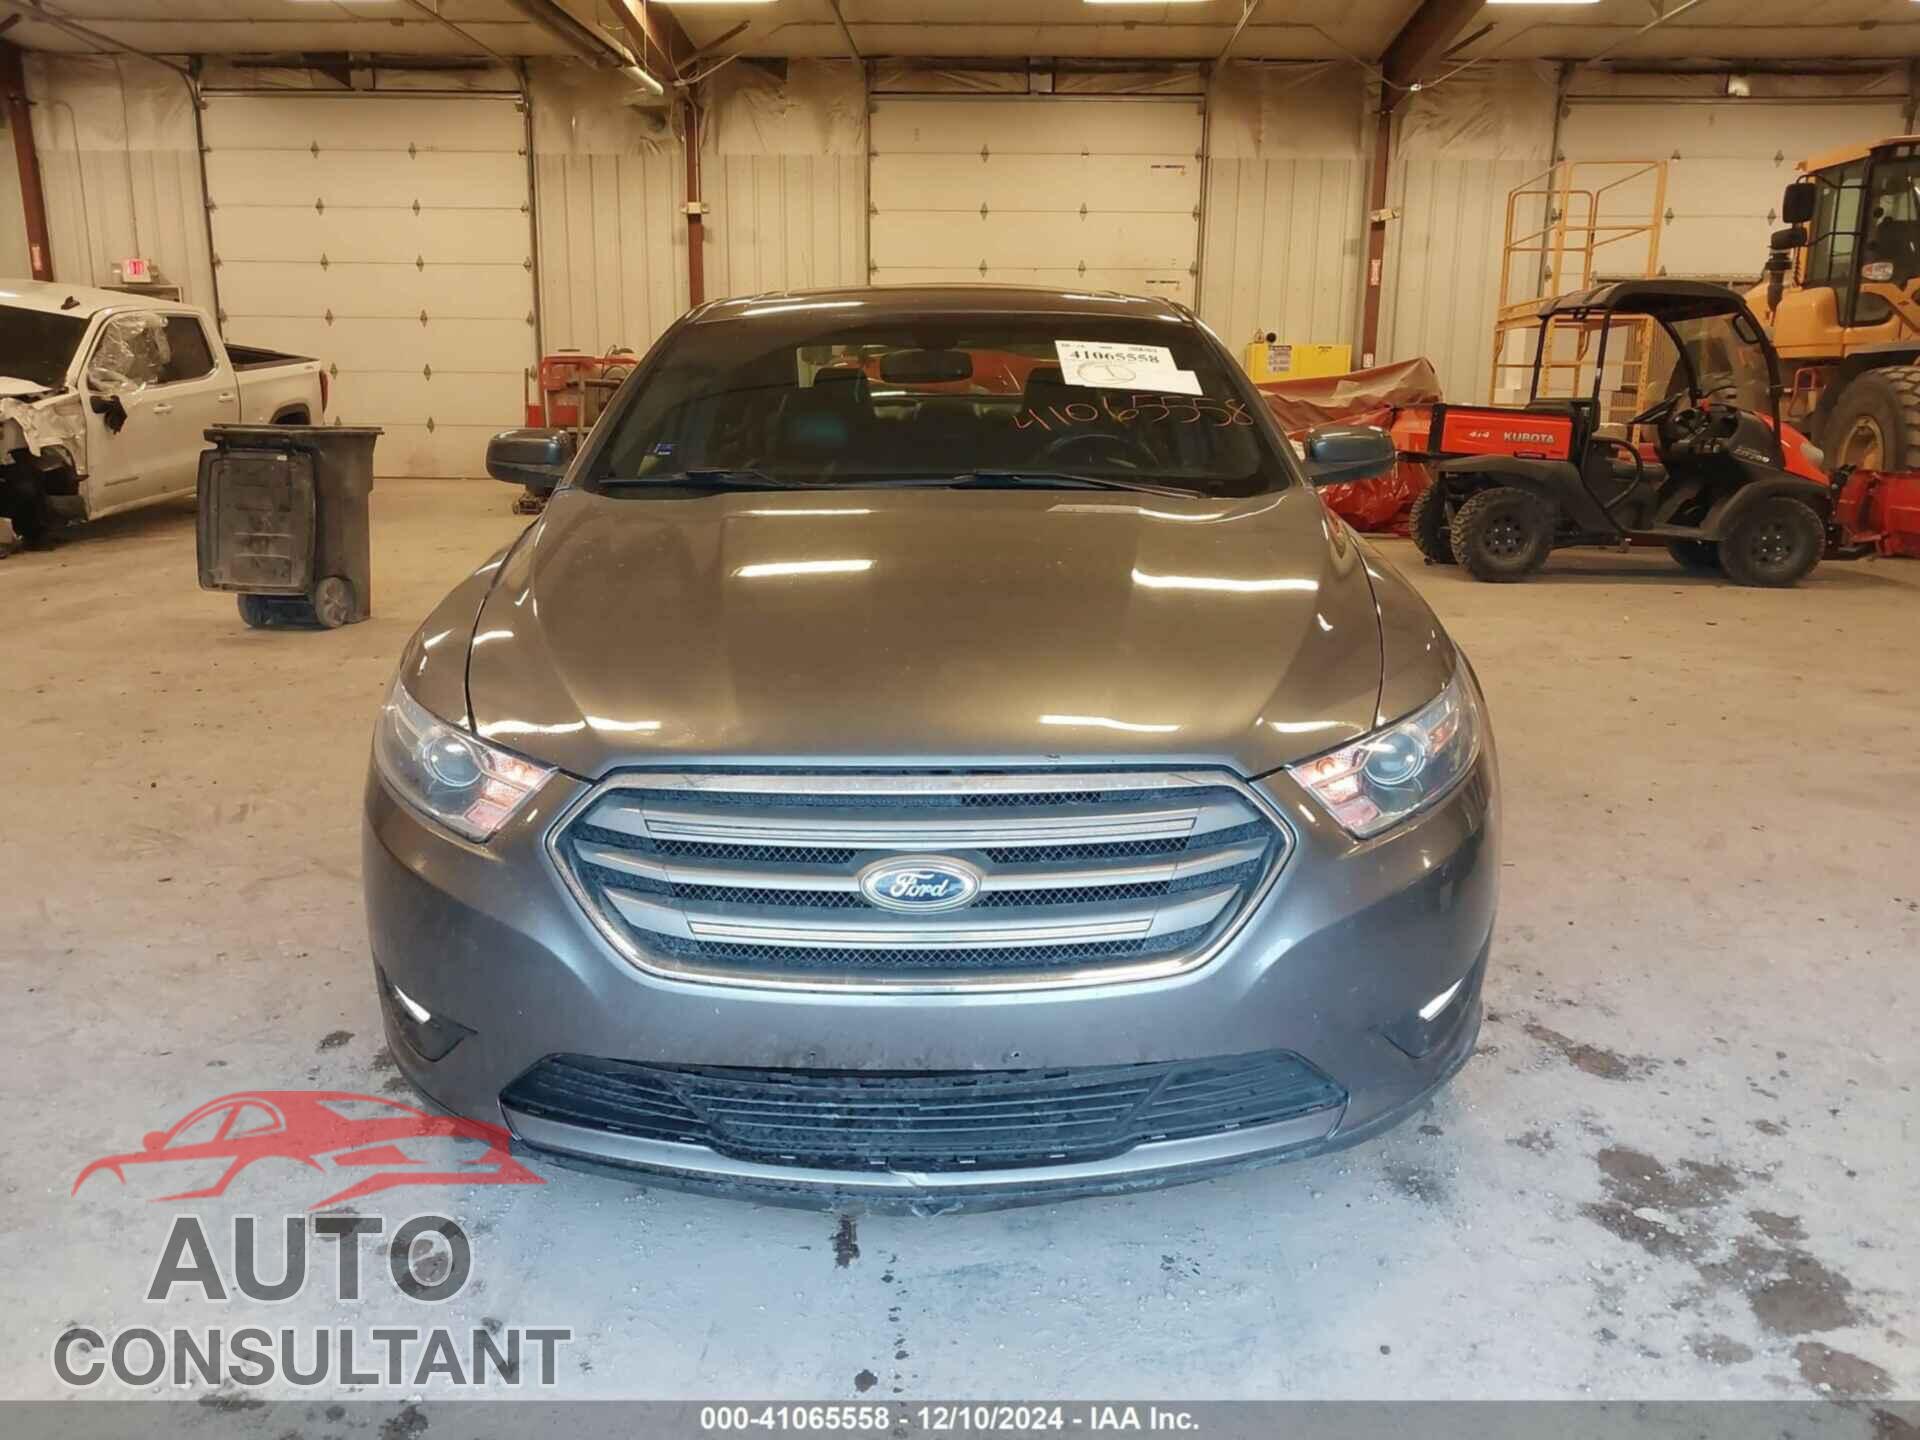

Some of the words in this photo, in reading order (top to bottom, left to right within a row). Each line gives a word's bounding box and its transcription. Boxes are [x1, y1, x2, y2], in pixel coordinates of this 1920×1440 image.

[1070, 349, 1160, 364] 41065558
[1012, 394, 1254, 432] 41065558
[1503, 431, 1555, 444] KUBOTA
[889, 872, 949, 897] Ford
